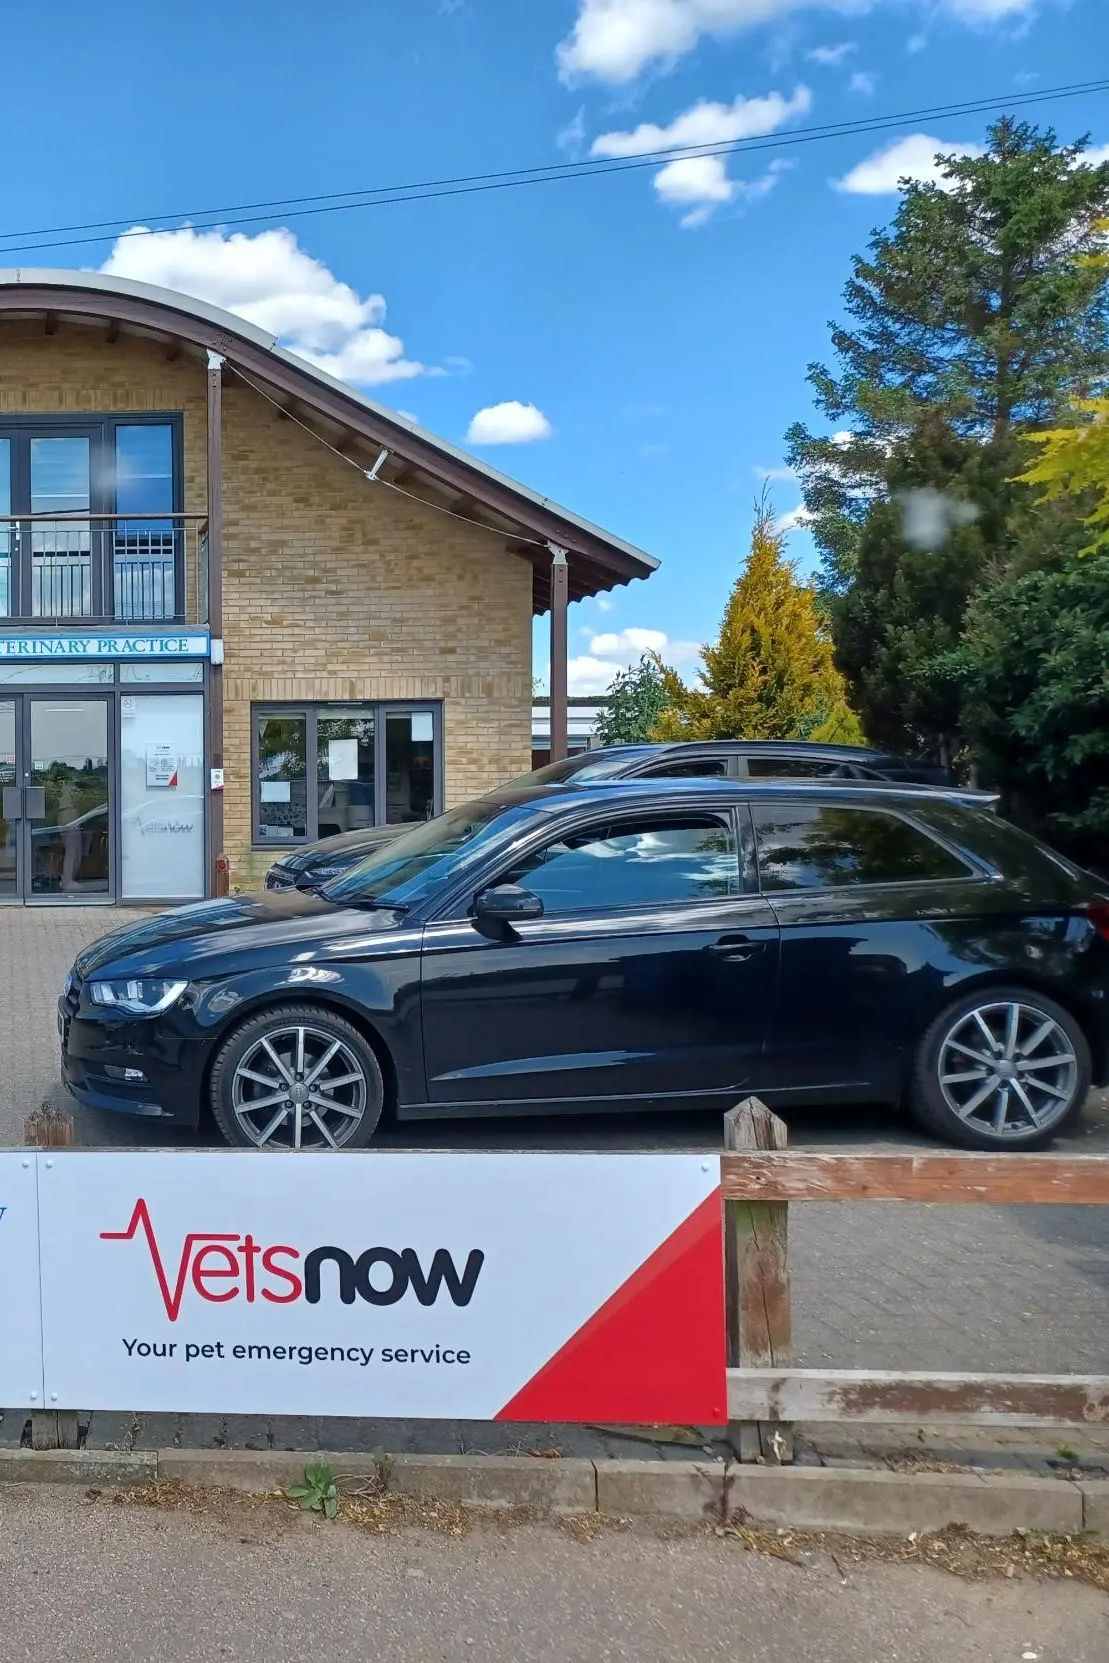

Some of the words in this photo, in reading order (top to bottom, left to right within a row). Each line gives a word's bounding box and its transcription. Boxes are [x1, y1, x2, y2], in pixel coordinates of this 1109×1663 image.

[97, 639, 189, 653] PRACTICE
[122, 1338, 178, 1358] Your
[185, 1341, 225, 1362] pet
[232, 1344, 374, 1367] emergency
[381, 1343, 472, 1365] service
